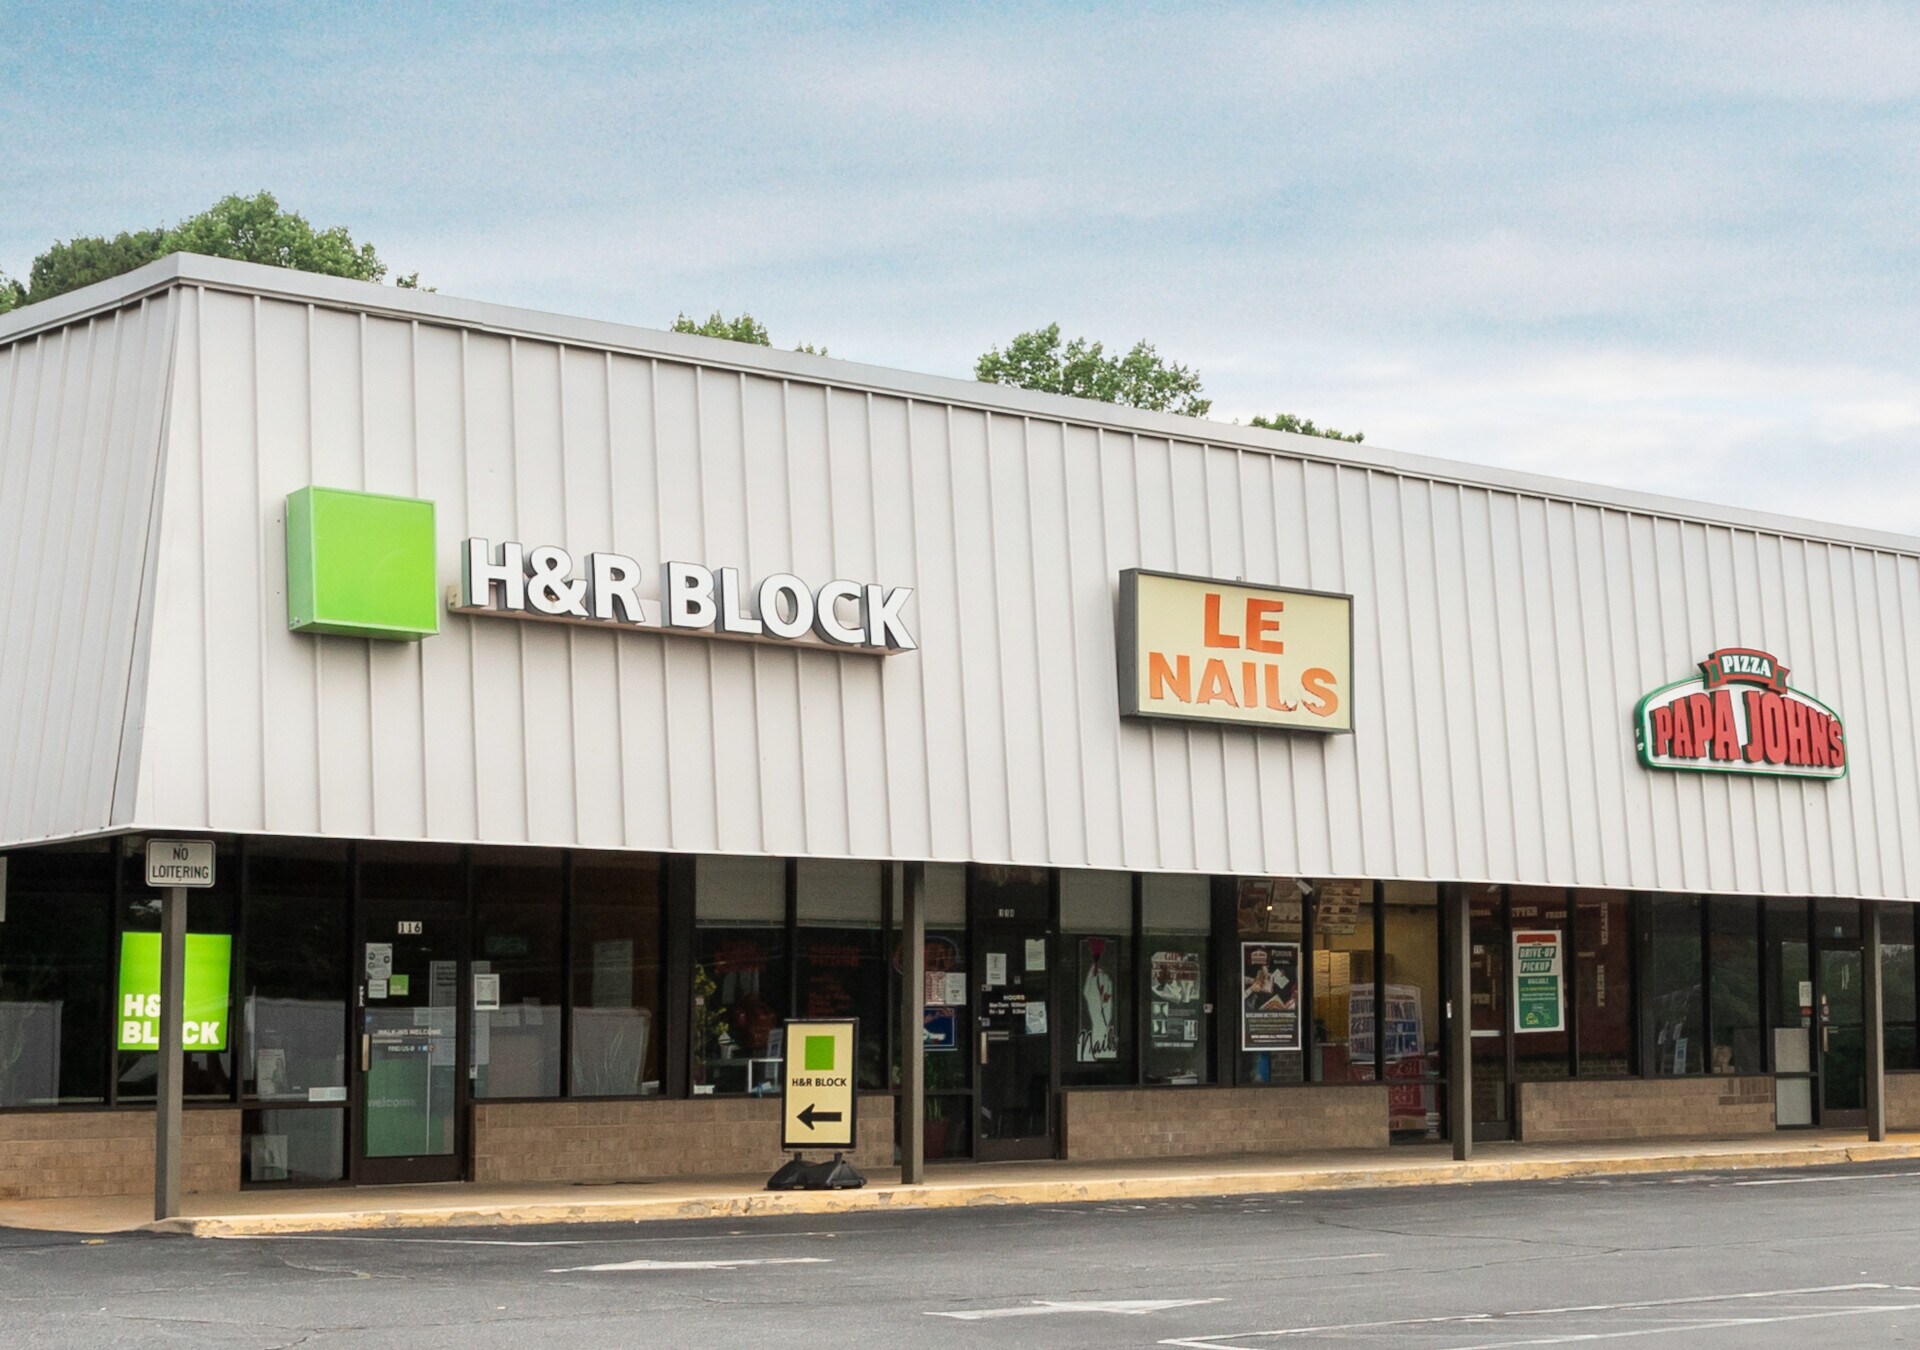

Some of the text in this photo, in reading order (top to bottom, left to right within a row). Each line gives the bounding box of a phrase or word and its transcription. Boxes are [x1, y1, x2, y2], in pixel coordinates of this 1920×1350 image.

[462, 537, 918, 650] H&R BLOCK
[1204, 593, 1284, 654] LE
[1721, 655, 1772, 678] PIZZA
[1149, 652, 1339, 718] NAILS
[1649, 690, 1846, 769] PAPA JOHN'S
[173, 848, 189, 861] NO
[152, 865, 209, 879] LOITERING
[399, 922, 421, 933] 116
[1519, 948, 1556, 959] DRIVE-UP
[1521, 961, 1550, 973] PICKUP
[124, 994, 162, 1018] H&
[122, 1021, 220, 1045] BLCK
[792, 1077, 848, 1087] H&R BLOCK
